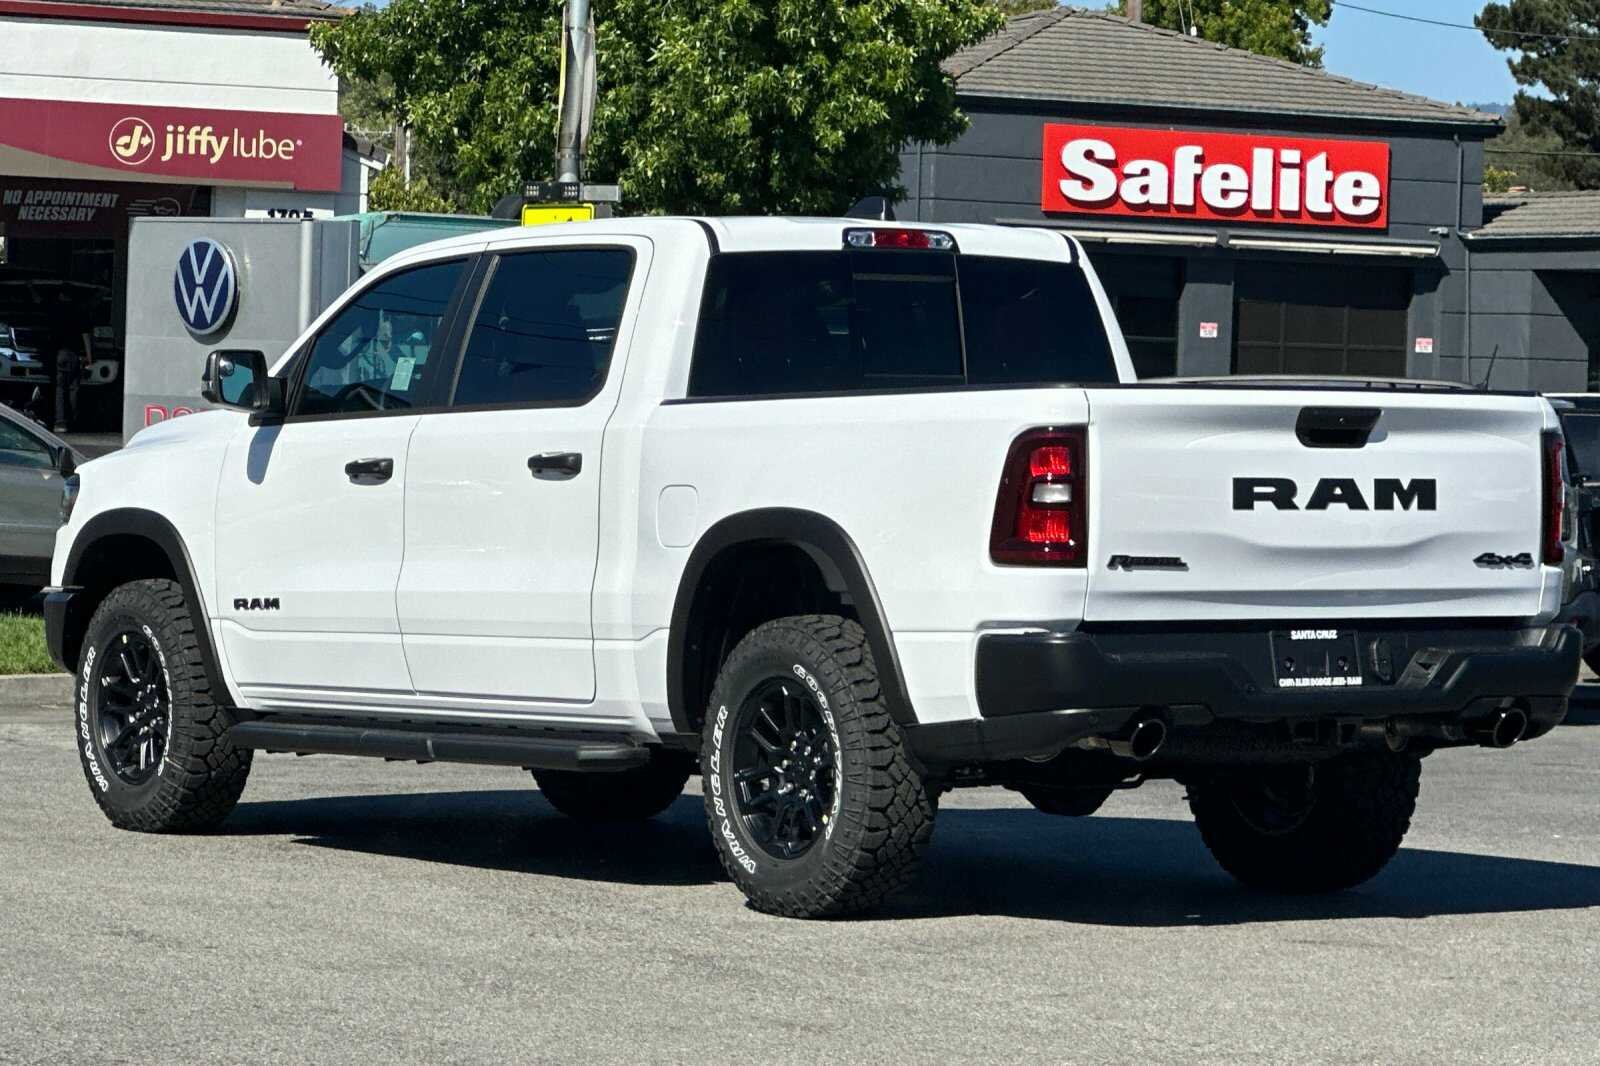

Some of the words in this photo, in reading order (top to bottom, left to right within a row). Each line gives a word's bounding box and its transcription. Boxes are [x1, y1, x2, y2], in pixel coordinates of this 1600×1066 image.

[161, 124, 229, 164] jiffy
[232, 128, 296, 160] lube
[1059, 138, 1381, 217] Safelite
[3, 190, 22, 204] NO
[24, 190, 119, 208] APPOINTMENT
[18, 206, 96, 221] NECESSARY
[1233, 477, 1437, 511] RAM
[233, 597, 280, 610] RAM
[1290, 630, 1316, 640] SANTA
[1316, 629, 1338, 639] CRUZ
[711, 705, 757, 875] WRANGLER
